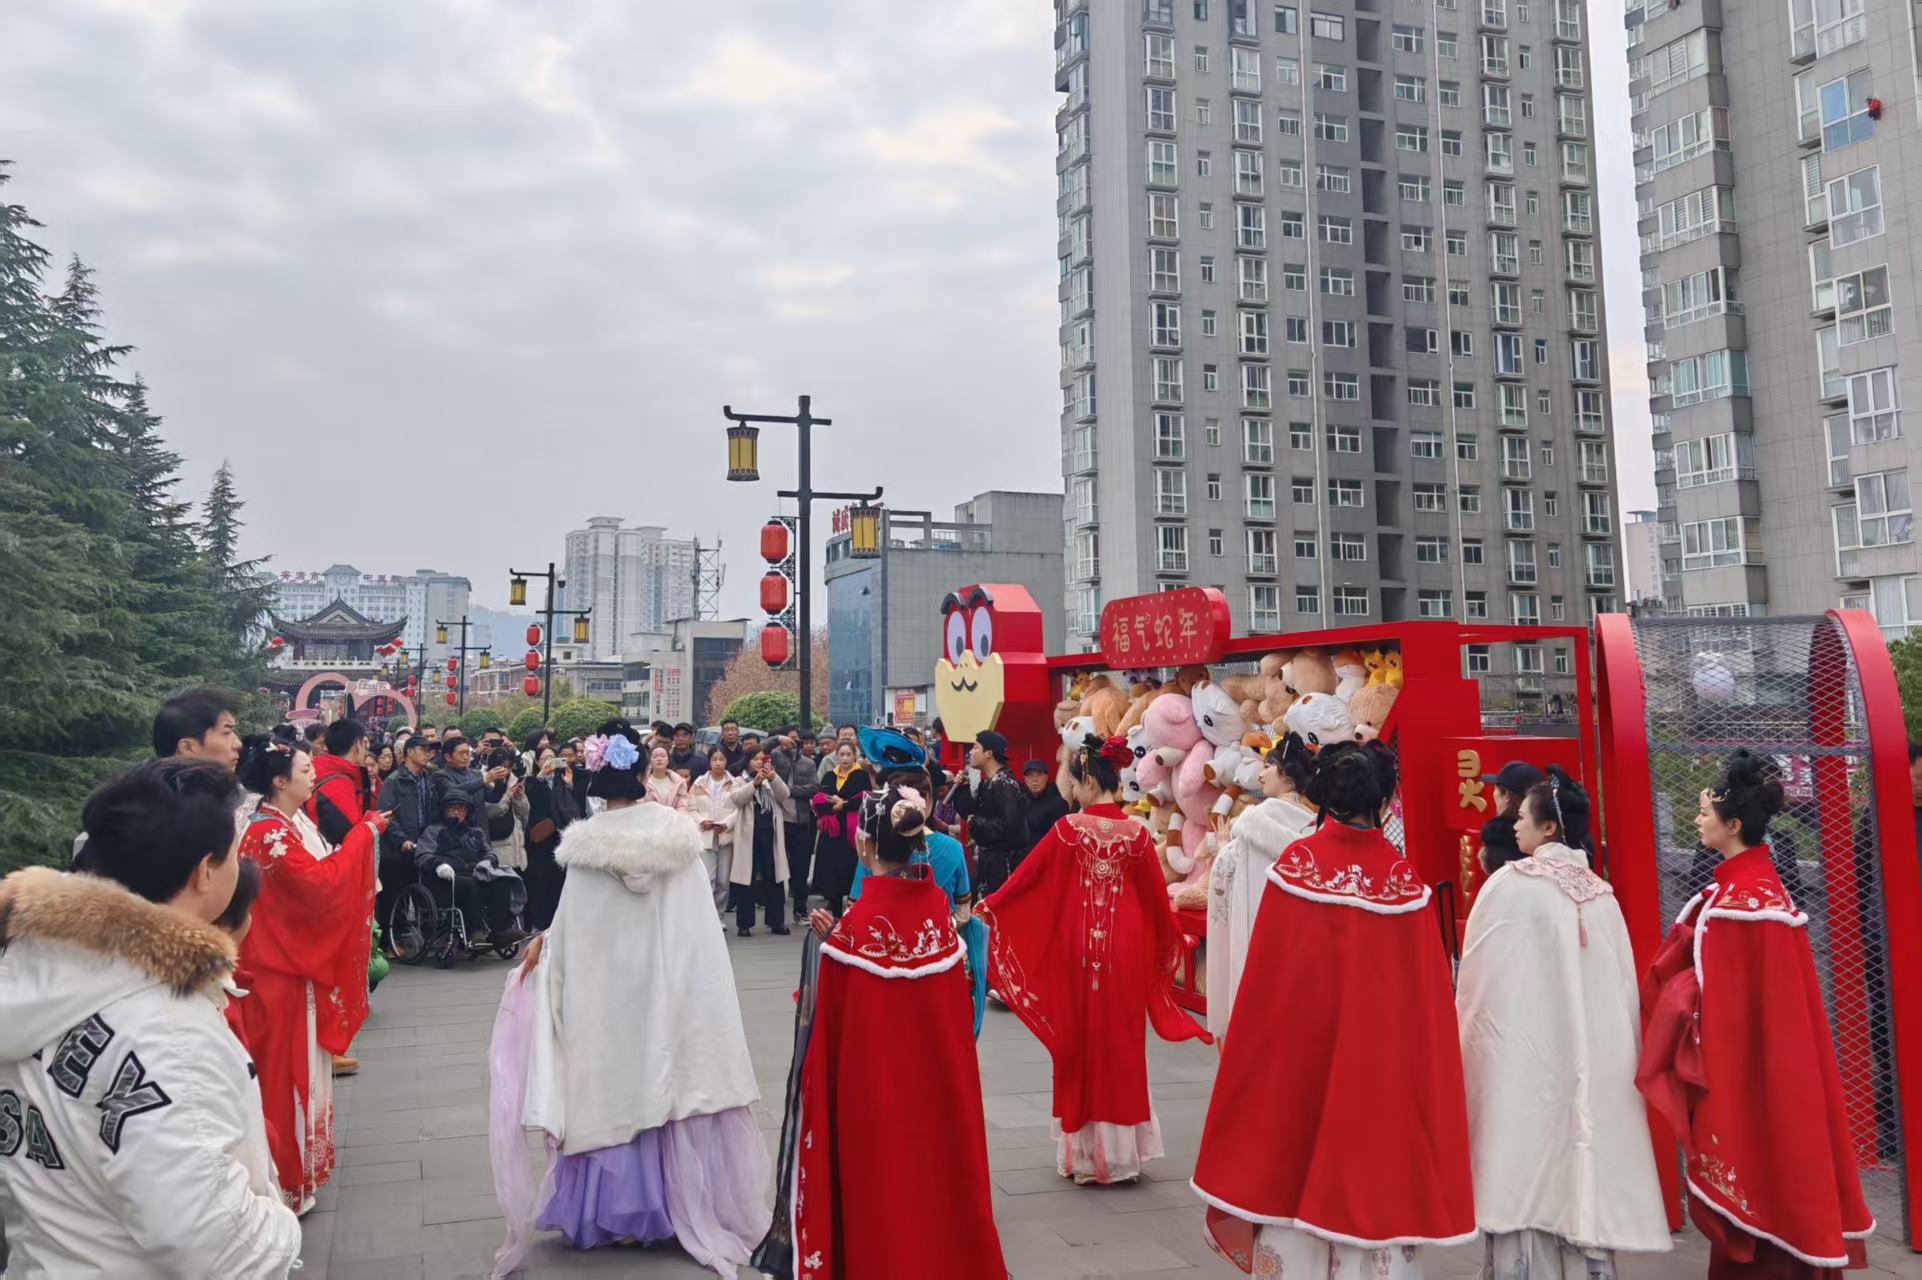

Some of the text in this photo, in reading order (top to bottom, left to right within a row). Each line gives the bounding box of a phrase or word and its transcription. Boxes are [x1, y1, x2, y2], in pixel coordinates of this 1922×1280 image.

[1112, 608, 1198, 655] 福气蛇年
[1457, 749, 1488, 813] 灵
[32, 1013, 173, 1155] EY
